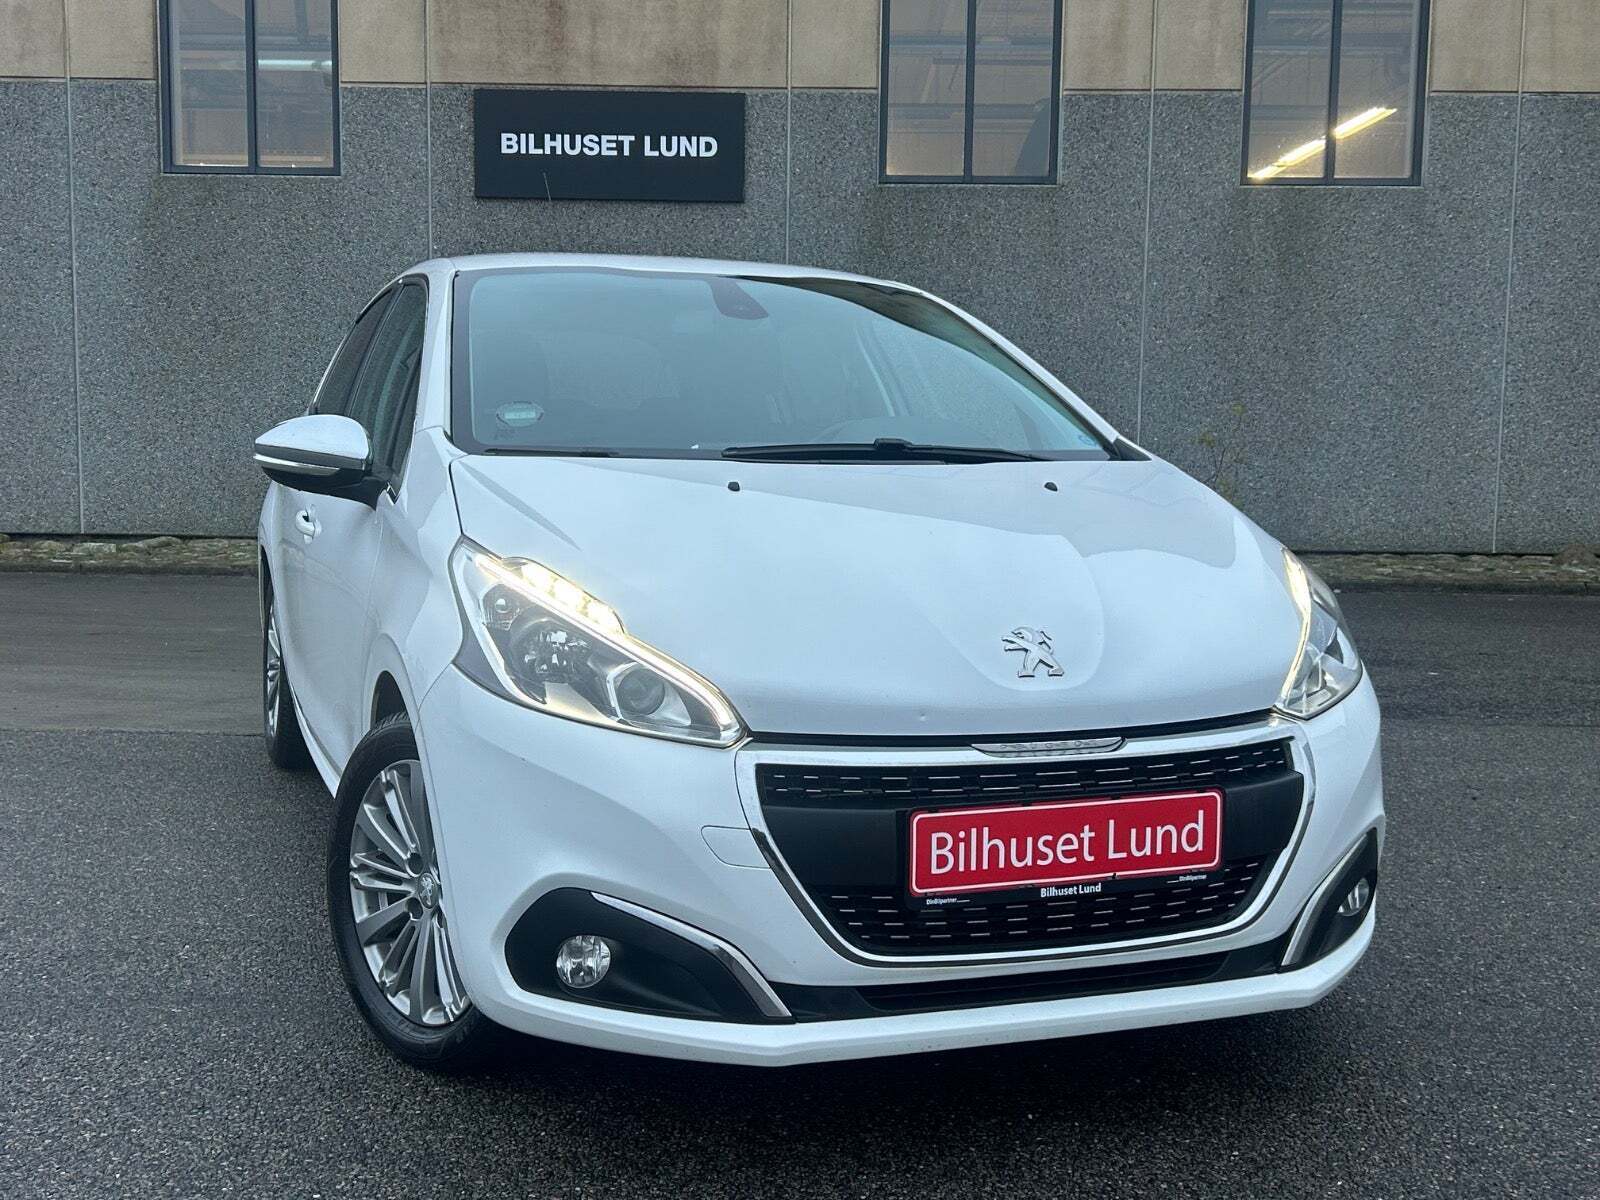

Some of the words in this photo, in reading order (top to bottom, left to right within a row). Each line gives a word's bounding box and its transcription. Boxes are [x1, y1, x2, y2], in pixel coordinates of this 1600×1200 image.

[501, 133, 635, 156] BILHUSET
[644, 136, 718, 157] LUND
[930, 826, 1095, 875] Bilhuset
[1108, 809, 1205, 860] Lund
[1041, 886, 1078, 898] Bilhuset
[1079, 882, 1102, 894] Lund
